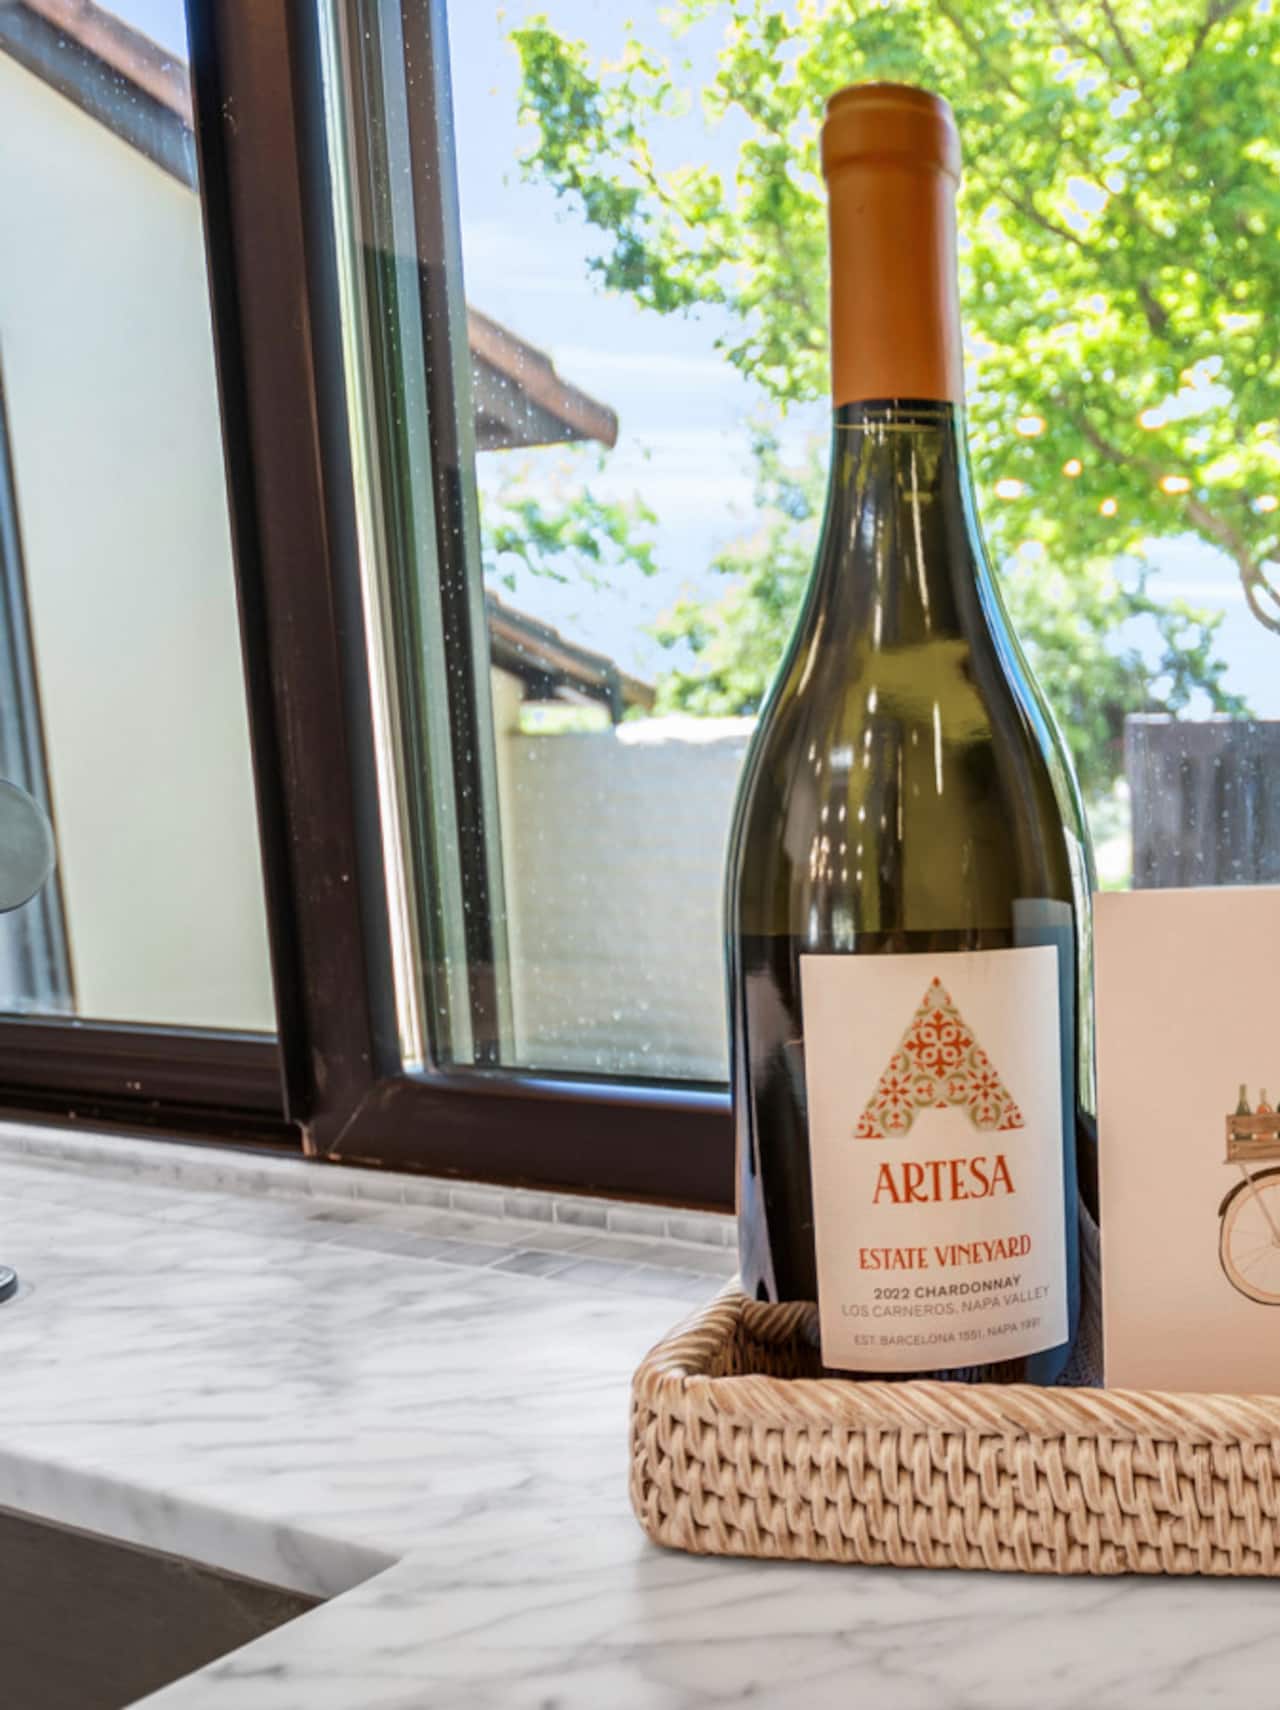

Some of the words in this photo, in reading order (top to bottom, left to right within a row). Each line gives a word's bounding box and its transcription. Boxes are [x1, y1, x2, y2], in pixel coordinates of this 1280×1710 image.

[872, 1154, 1016, 1204] ARTESA
[859, 1247, 928, 1270] ESTATE
[934, 1233, 1032, 1268] VINEYARD
[841, 1303, 869, 1318] LOS
[961, 1295, 1001, 1313] NAPA
[1003, 1283, 1049, 1306] VALLEY
[873, 1286, 910, 1300] 2022
[914, 1274, 1021, 1298] CHARDONNAY
[879, 1331, 956, 1347] BARCELONA
[987, 1321, 1018, 1337] NAPA
